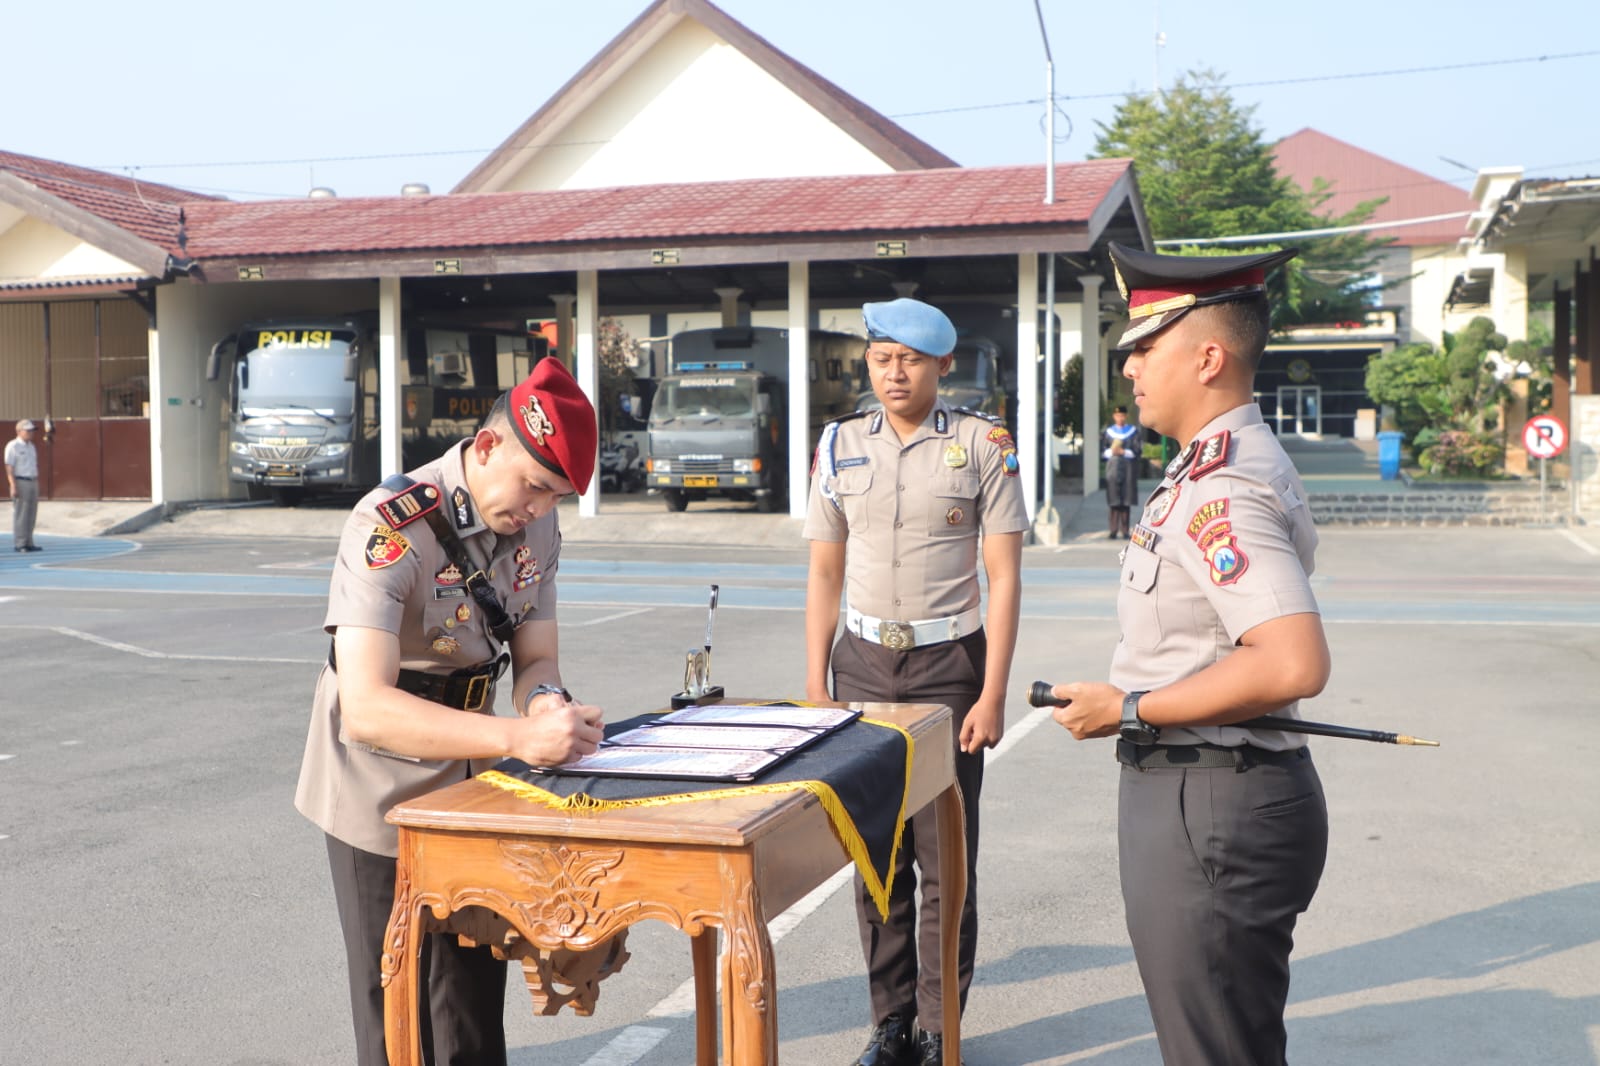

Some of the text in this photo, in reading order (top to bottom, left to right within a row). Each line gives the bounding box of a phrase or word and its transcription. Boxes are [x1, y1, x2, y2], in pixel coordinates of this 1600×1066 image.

[258, 331, 332, 349] POLISI
[448, 397, 497, 416] POLIS
[1536, 425, 1553, 448] P
[1190, 501, 1224, 534] POLRES
